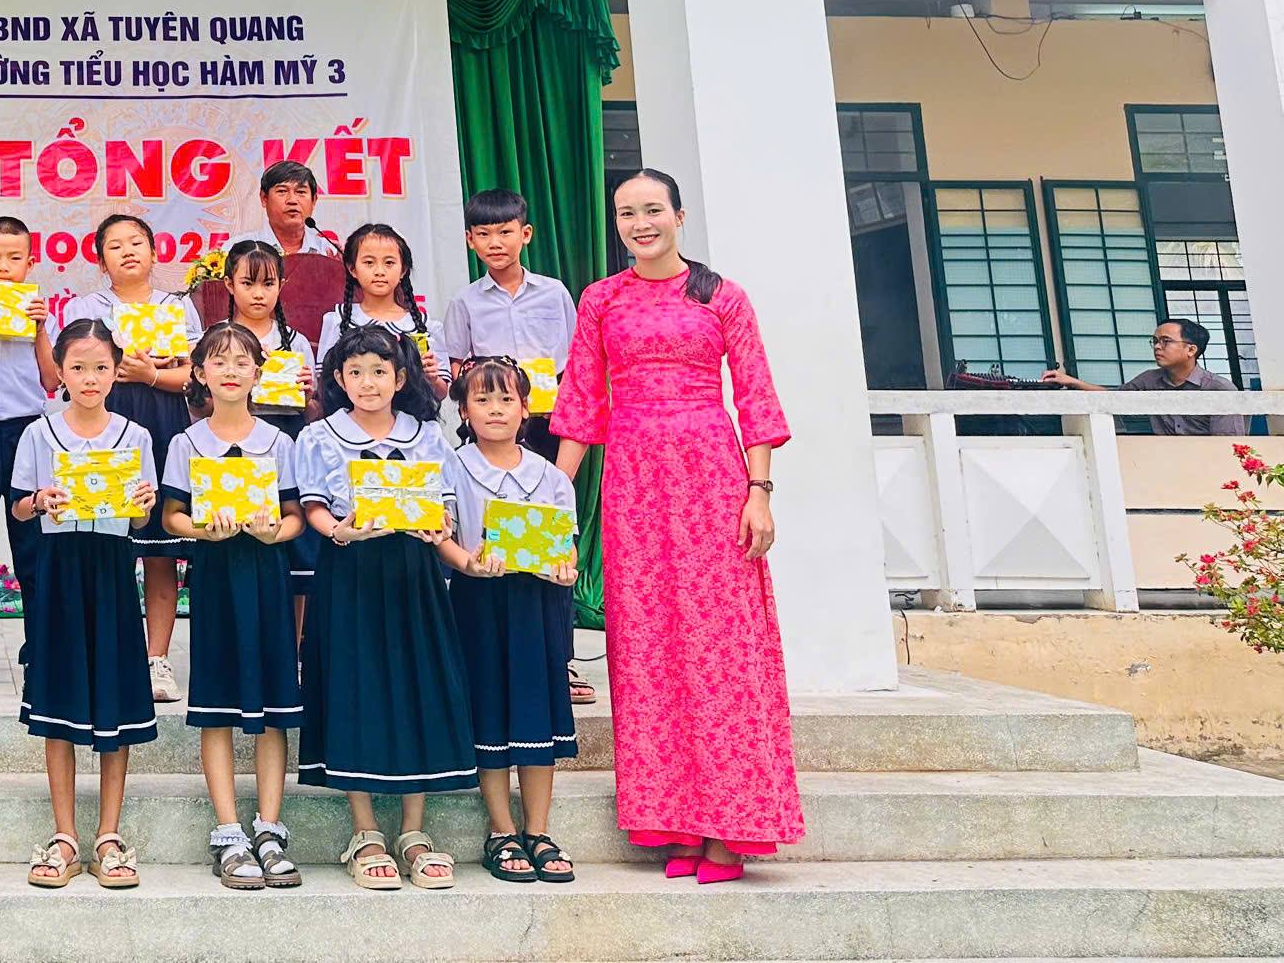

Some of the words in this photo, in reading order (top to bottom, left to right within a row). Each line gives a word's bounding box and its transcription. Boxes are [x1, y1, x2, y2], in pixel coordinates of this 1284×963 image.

[61, 11, 100, 42] XÃ
[108, 11, 200, 42] TUYÊN
[209, 15, 304, 44] QUANG
[59, 49, 122, 86] TIỂU
[132, 60, 190, 92] HỌC
[199, 54, 265, 86] HÀM
[274, 54, 318, 85] MỸ
[327, 58, 346, 84] 3
